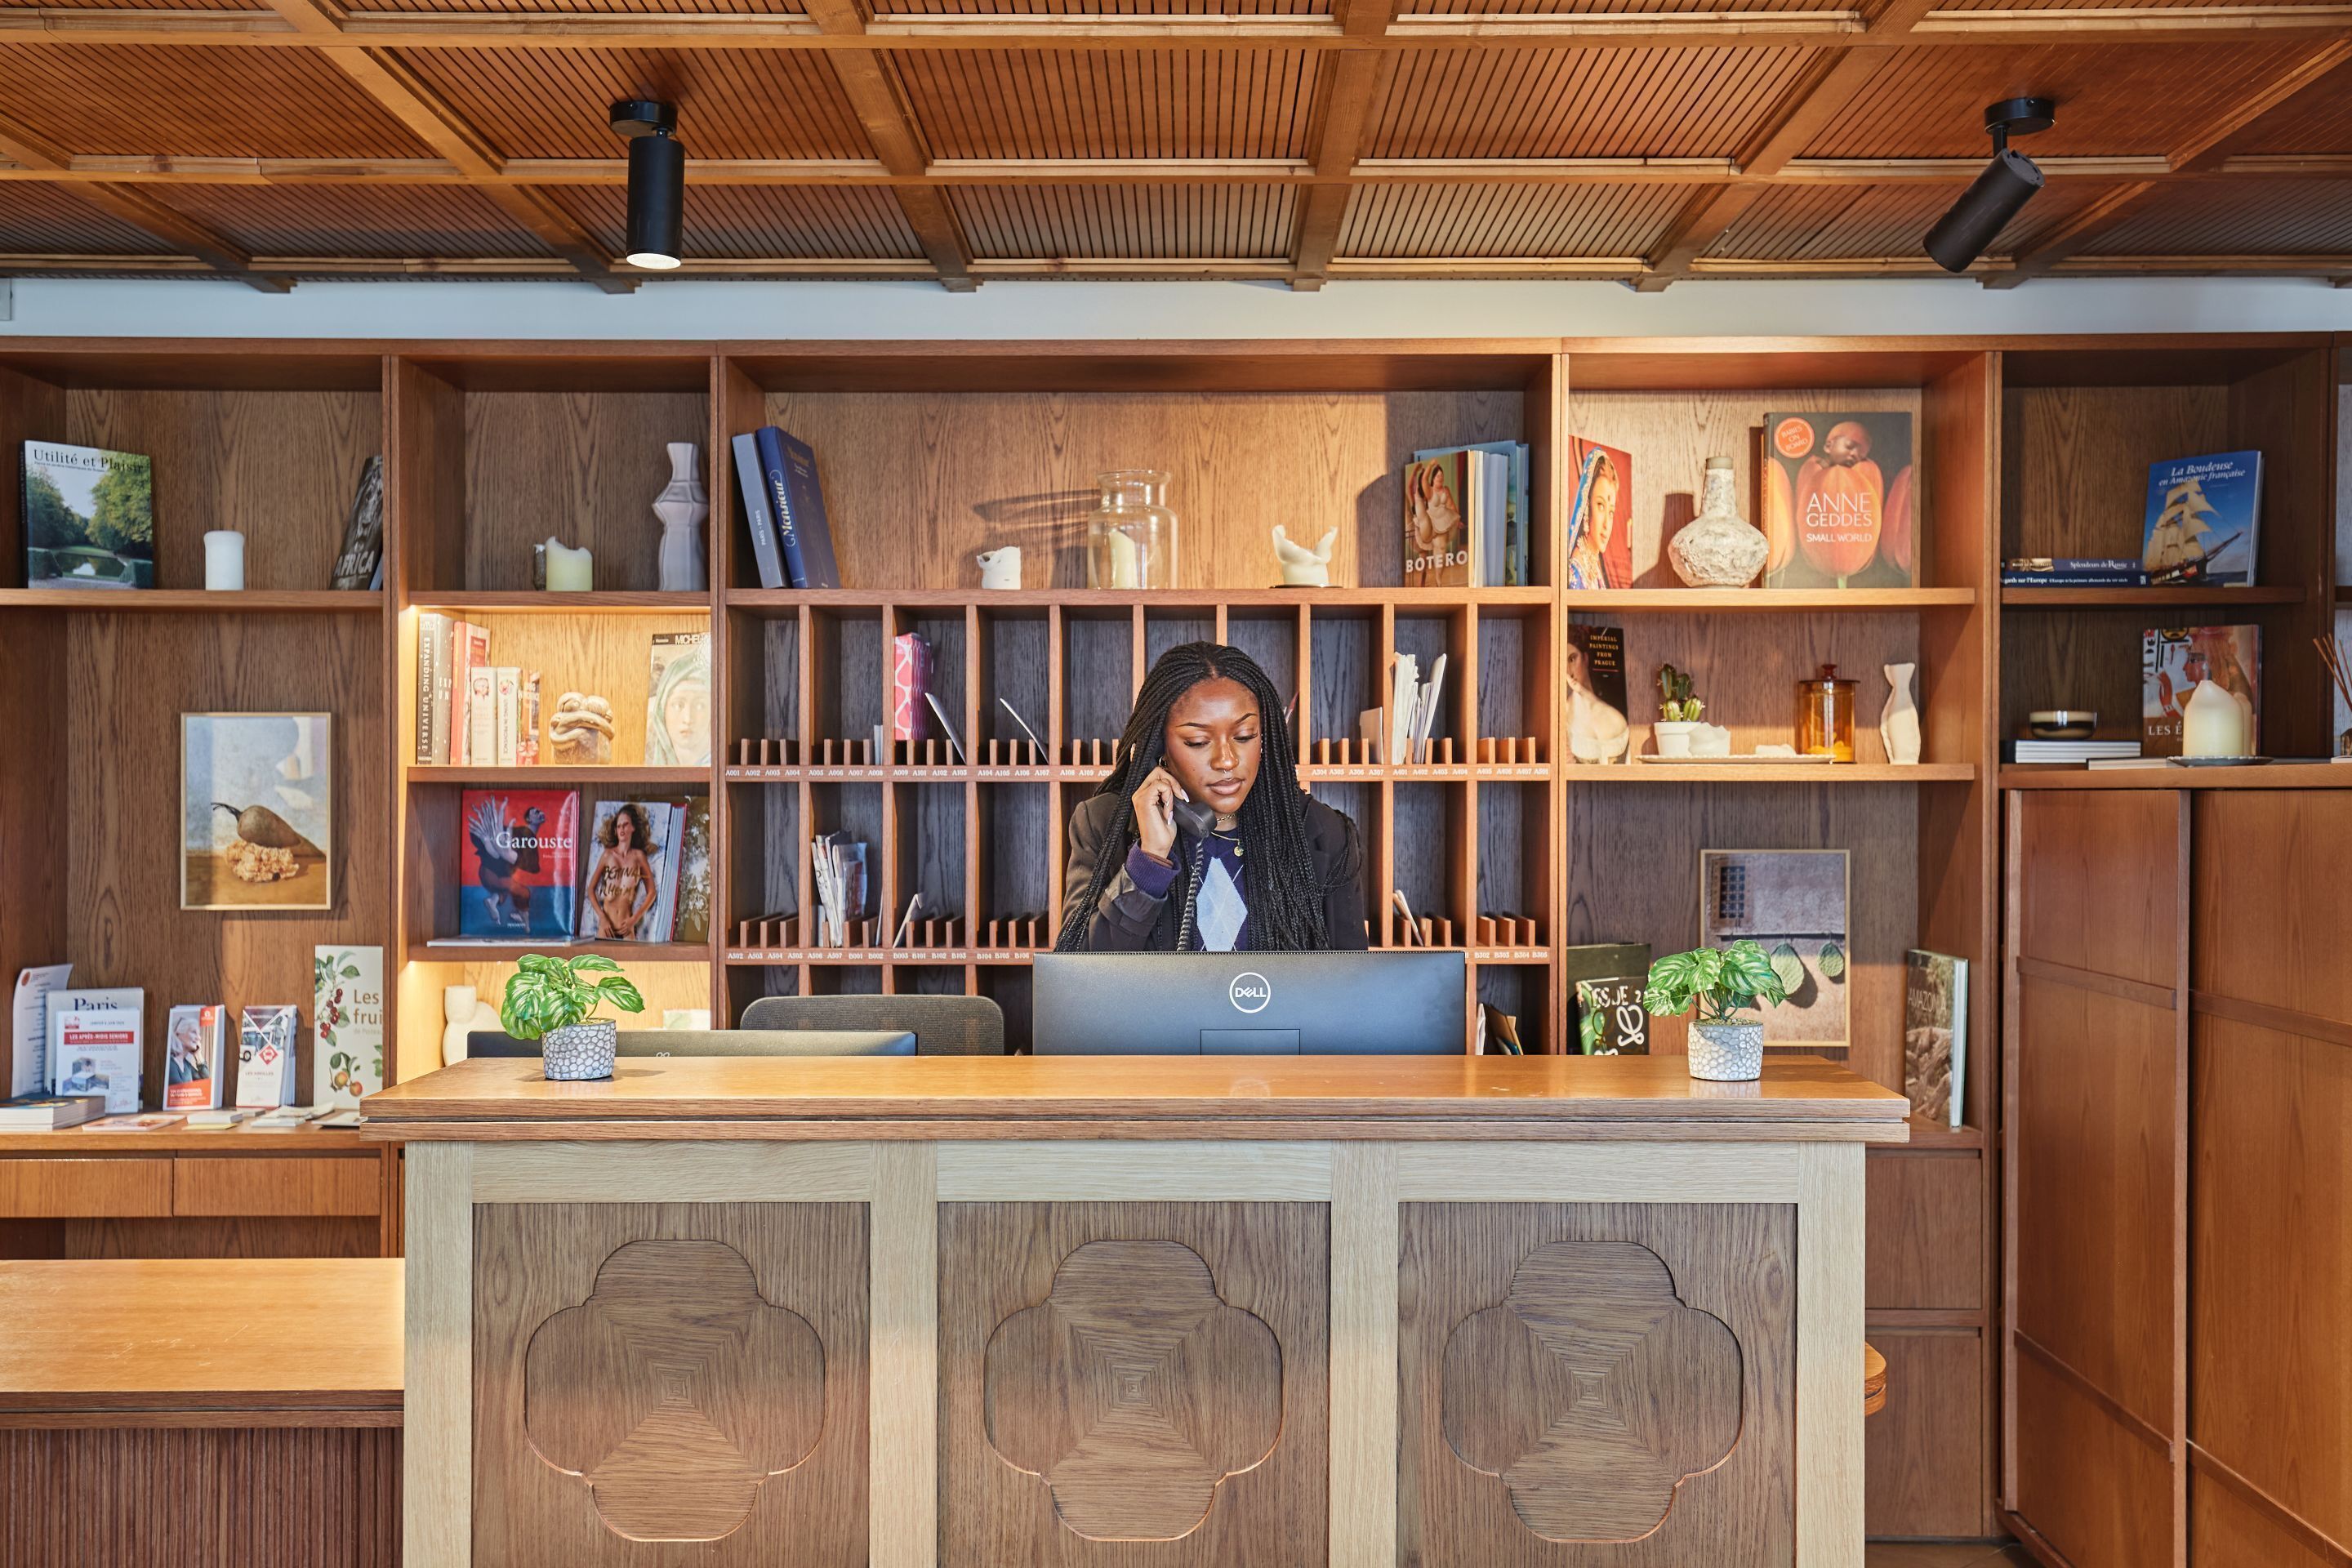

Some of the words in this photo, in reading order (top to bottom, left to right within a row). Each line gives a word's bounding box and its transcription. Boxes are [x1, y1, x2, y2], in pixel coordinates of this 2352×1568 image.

[1785, 438, 1808, 451] BOARD
[1788, 434, 1800, 442] ON
[33, 448, 78, 465] Utilité
[83, 457, 96, 467] et
[100, 457, 144, 472] Plaisir
[2171, 467, 2184, 476] La
[2186, 461, 2234, 474] Boudeuse
[2158, 479, 2168, 487] en
[2207, 470, 2246, 482] française
[769, 469, 795, 547] Monsieur
[1806, 492, 1872, 513] ANNE
[1806, 512, 1873, 528] GEDDES
[1806, 532, 1836, 543] SMALL
[1837, 532, 1873, 543] WORLD
[333, 550, 375, 577] AFRICA
[1405, 550, 1468, 573] BOTERO
[2069, 560, 2100, 570] Splendeurs
[2100, 560, 2107, 568] de
[2001, 577, 2017, 585] gards
[423, 637, 431, 693] EXPANDING
[421, 697, 430, 751] UNIVERSE
[2148, 724, 2171, 736] LES
[496, 831, 572, 849] Garouste
[354, 989, 379, 1004] Les
[1235, 987, 1267, 998] DELL
[74, 996, 118, 1011] Paris
[353, 1008, 382, 1025] frui
